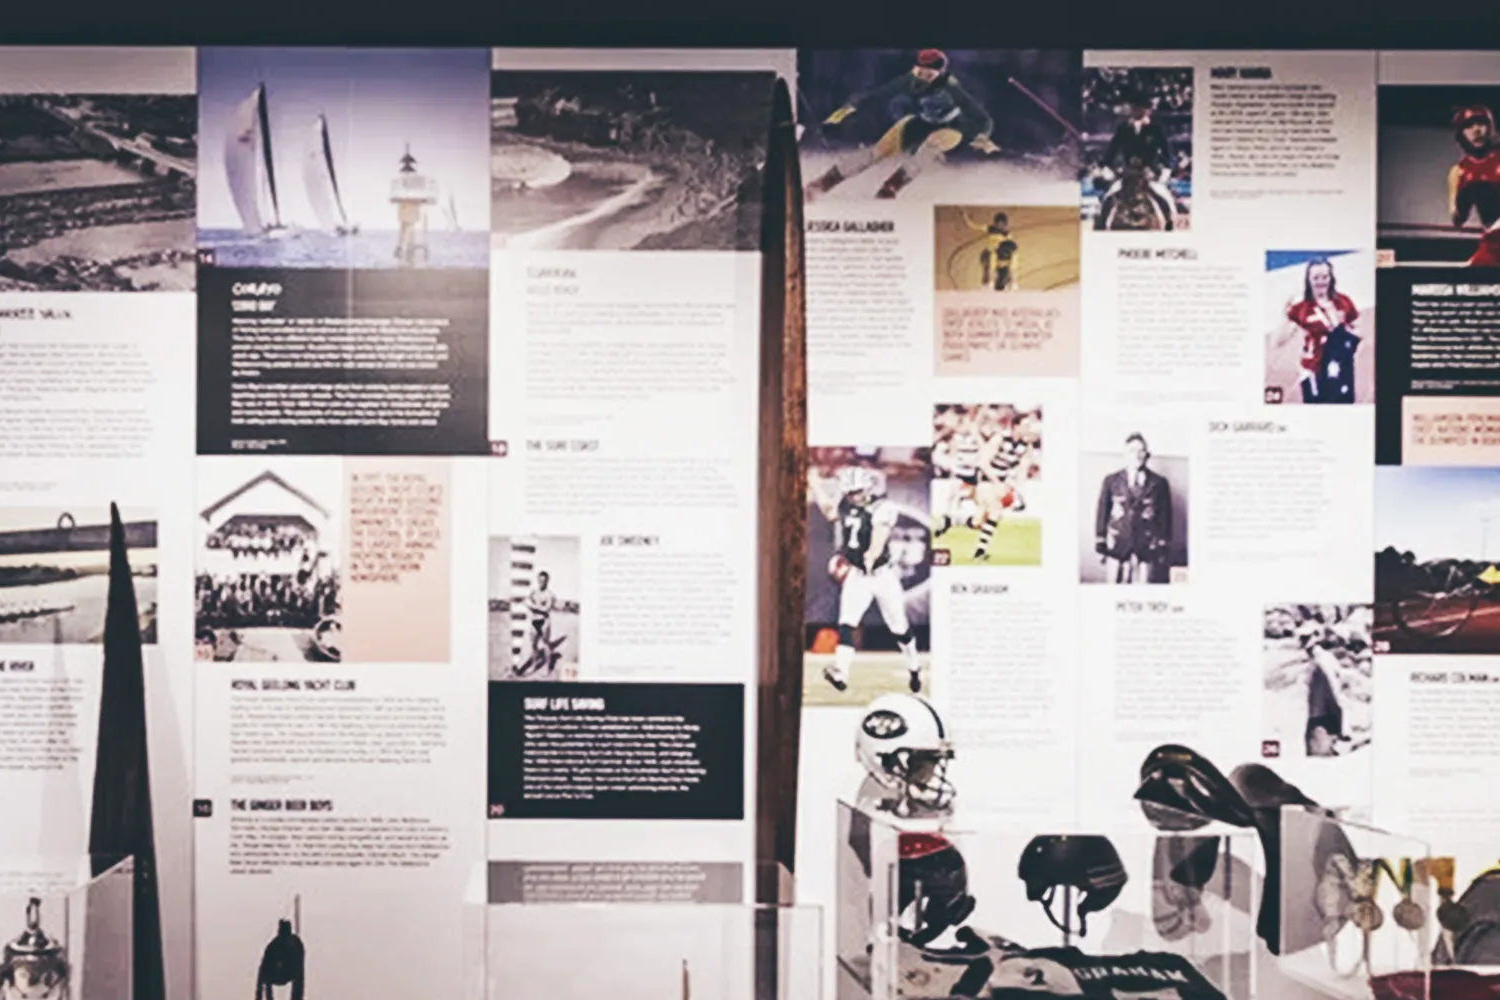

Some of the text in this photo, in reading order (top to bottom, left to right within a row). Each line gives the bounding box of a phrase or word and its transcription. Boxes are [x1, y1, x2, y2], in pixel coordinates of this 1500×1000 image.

[9, 660, 35, 673] RIVER
[230, 679, 356, 691] ROYAL GEELONG YACHT CLUB
[523, 697, 606, 711] SURF LIFE SAVING
[231, 798, 333, 812] THE GINGER BEER BOYS
[1073, 966, 1189, 984] GRAHAM
